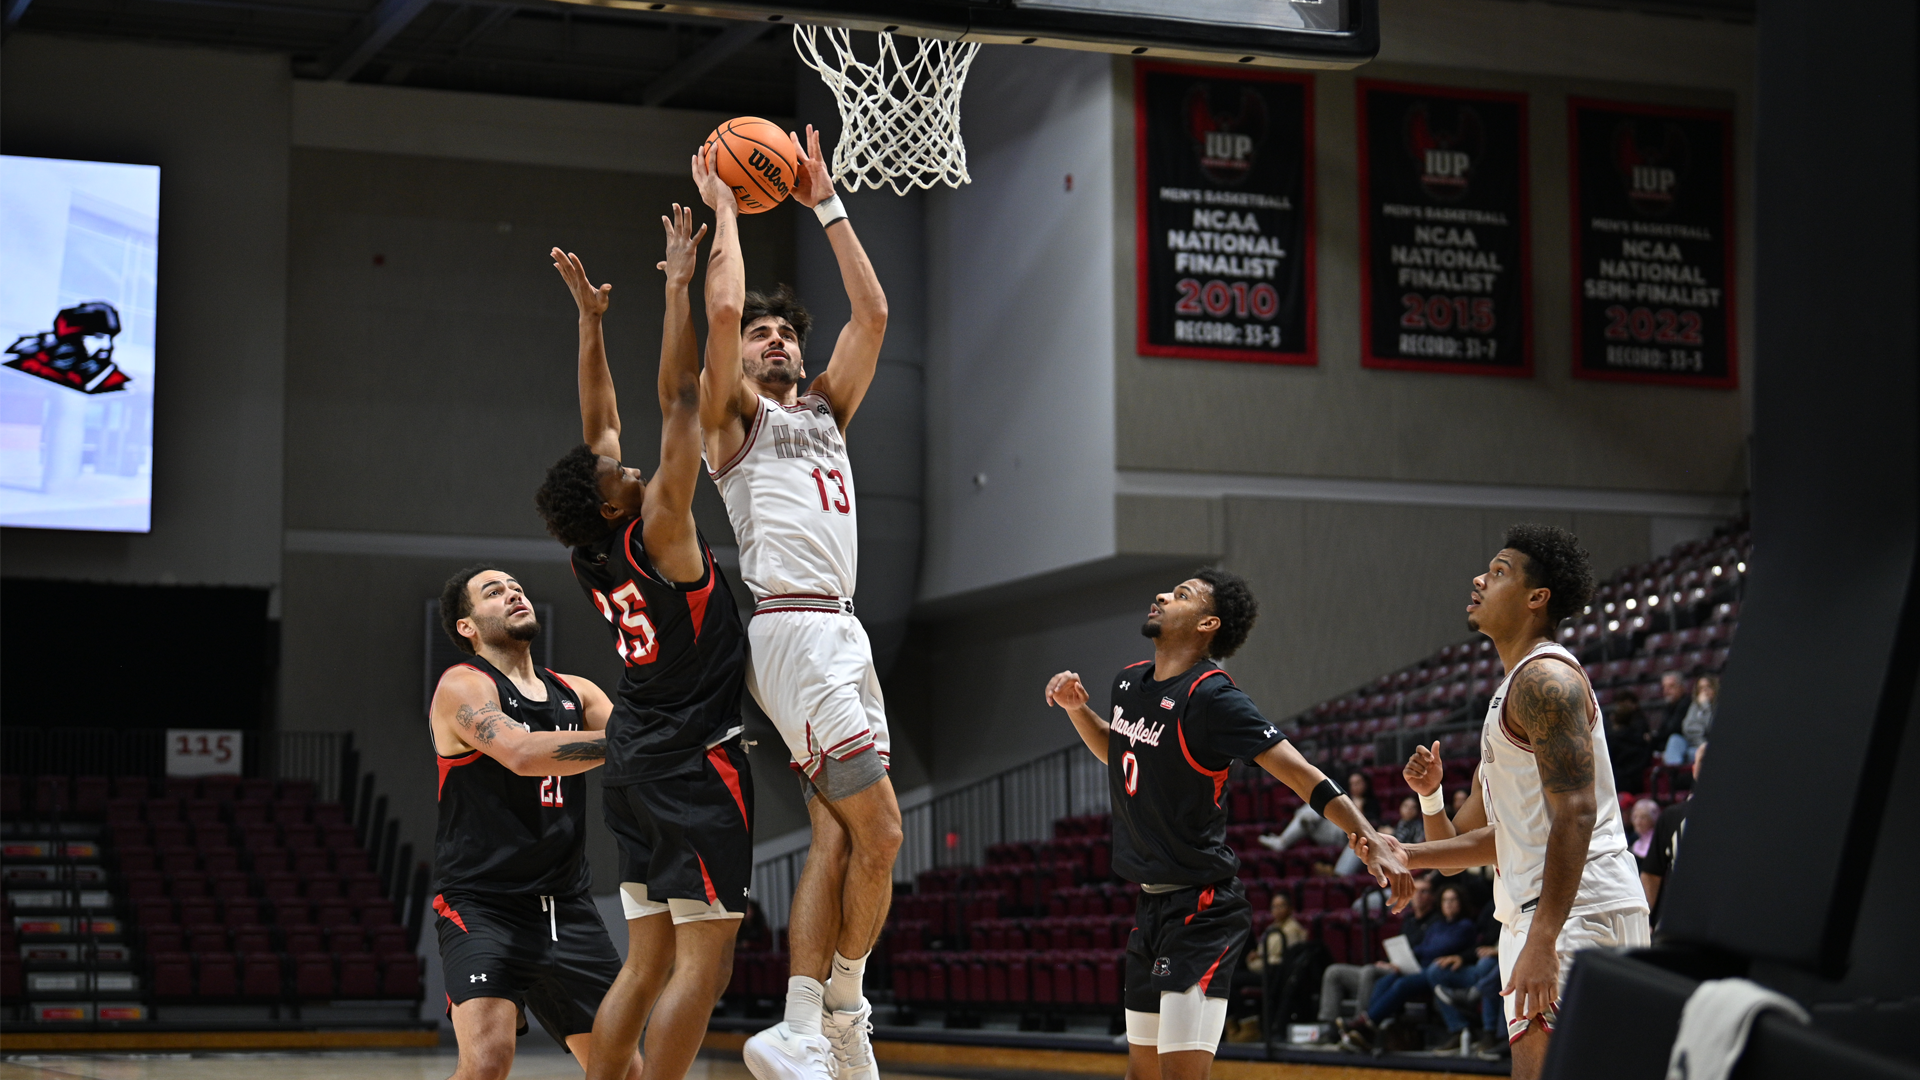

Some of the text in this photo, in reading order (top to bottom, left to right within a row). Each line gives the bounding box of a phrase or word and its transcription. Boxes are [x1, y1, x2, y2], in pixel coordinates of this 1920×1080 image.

[1206, 133, 1251, 158] IUP
[748, 148, 789, 198] Wilson
[1425, 150, 1469, 176] IUP
[1632, 167, 1675, 192] IUP
[1161, 188, 1291, 209] MEN'S BASKETBALL
[1194, 209, 1259, 232] NCAA
[1383, 203, 1509, 226] MEN'S BASKETBALL
[1415, 225, 1477, 248] NCAA
[1592, 218, 1712, 240] MEN'S BASKETBALL
[1169, 230, 1285, 257] NATIONAL
[1623, 239, 1682, 261] NCAA
[1176, 253, 1279, 278] FINALIST
[1391, 246, 1502, 271] NATIONAL
[1399, 268, 1496, 293] FINALIST
[1600, 259, 1706, 284] NATIONAL
[1176, 280, 1279, 319] 2010
[1585, 279, 1722, 307] SEMI-FINALIST
[1401, 294, 1494, 333] 2015
[1605, 306, 1702, 346] 2022
[1175, 321, 1241, 344] RECORD:
[1399, 334, 1462, 357] RECORD:
[1607, 346, 1667, 369] RECORD:
[809, 465, 851, 516] 13
[591, 578, 660, 668] 15
[1110, 704, 1165, 748] Mansfield
[176, 735, 232, 763] 115
[1122, 750, 1139, 797] 0
[540, 775, 563, 808] 21
